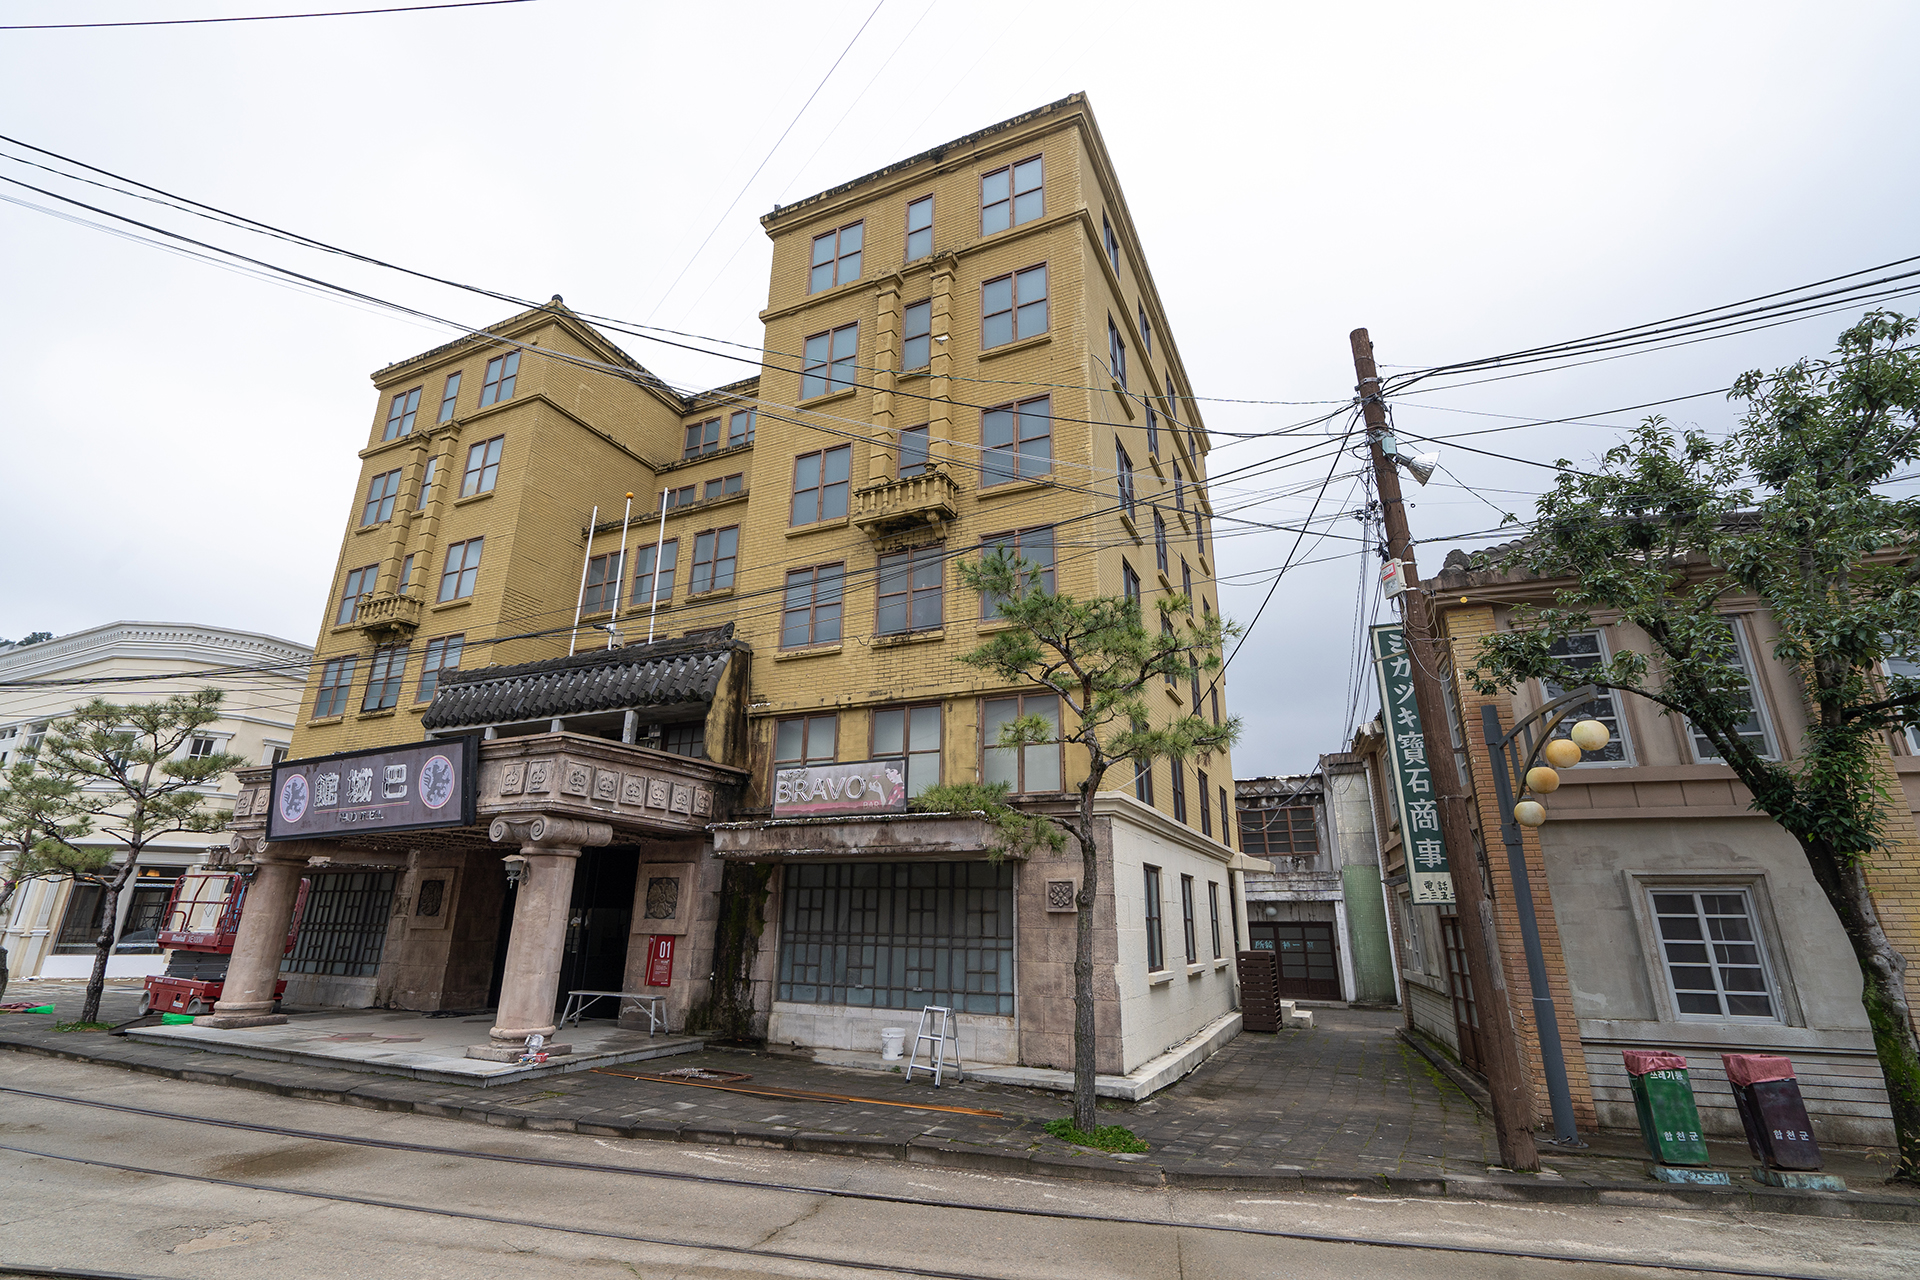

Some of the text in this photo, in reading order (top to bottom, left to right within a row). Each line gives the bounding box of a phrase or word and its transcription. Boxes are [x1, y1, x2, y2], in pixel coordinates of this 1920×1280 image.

[775, 774, 867, 804] BRAVO
[862, 800, 880, 810] BAR
[659, 940, 671, 959] 01
[1663, 1130, 1699, 1142] 합천군
[1772, 1129, 1810, 1141] 합천군
